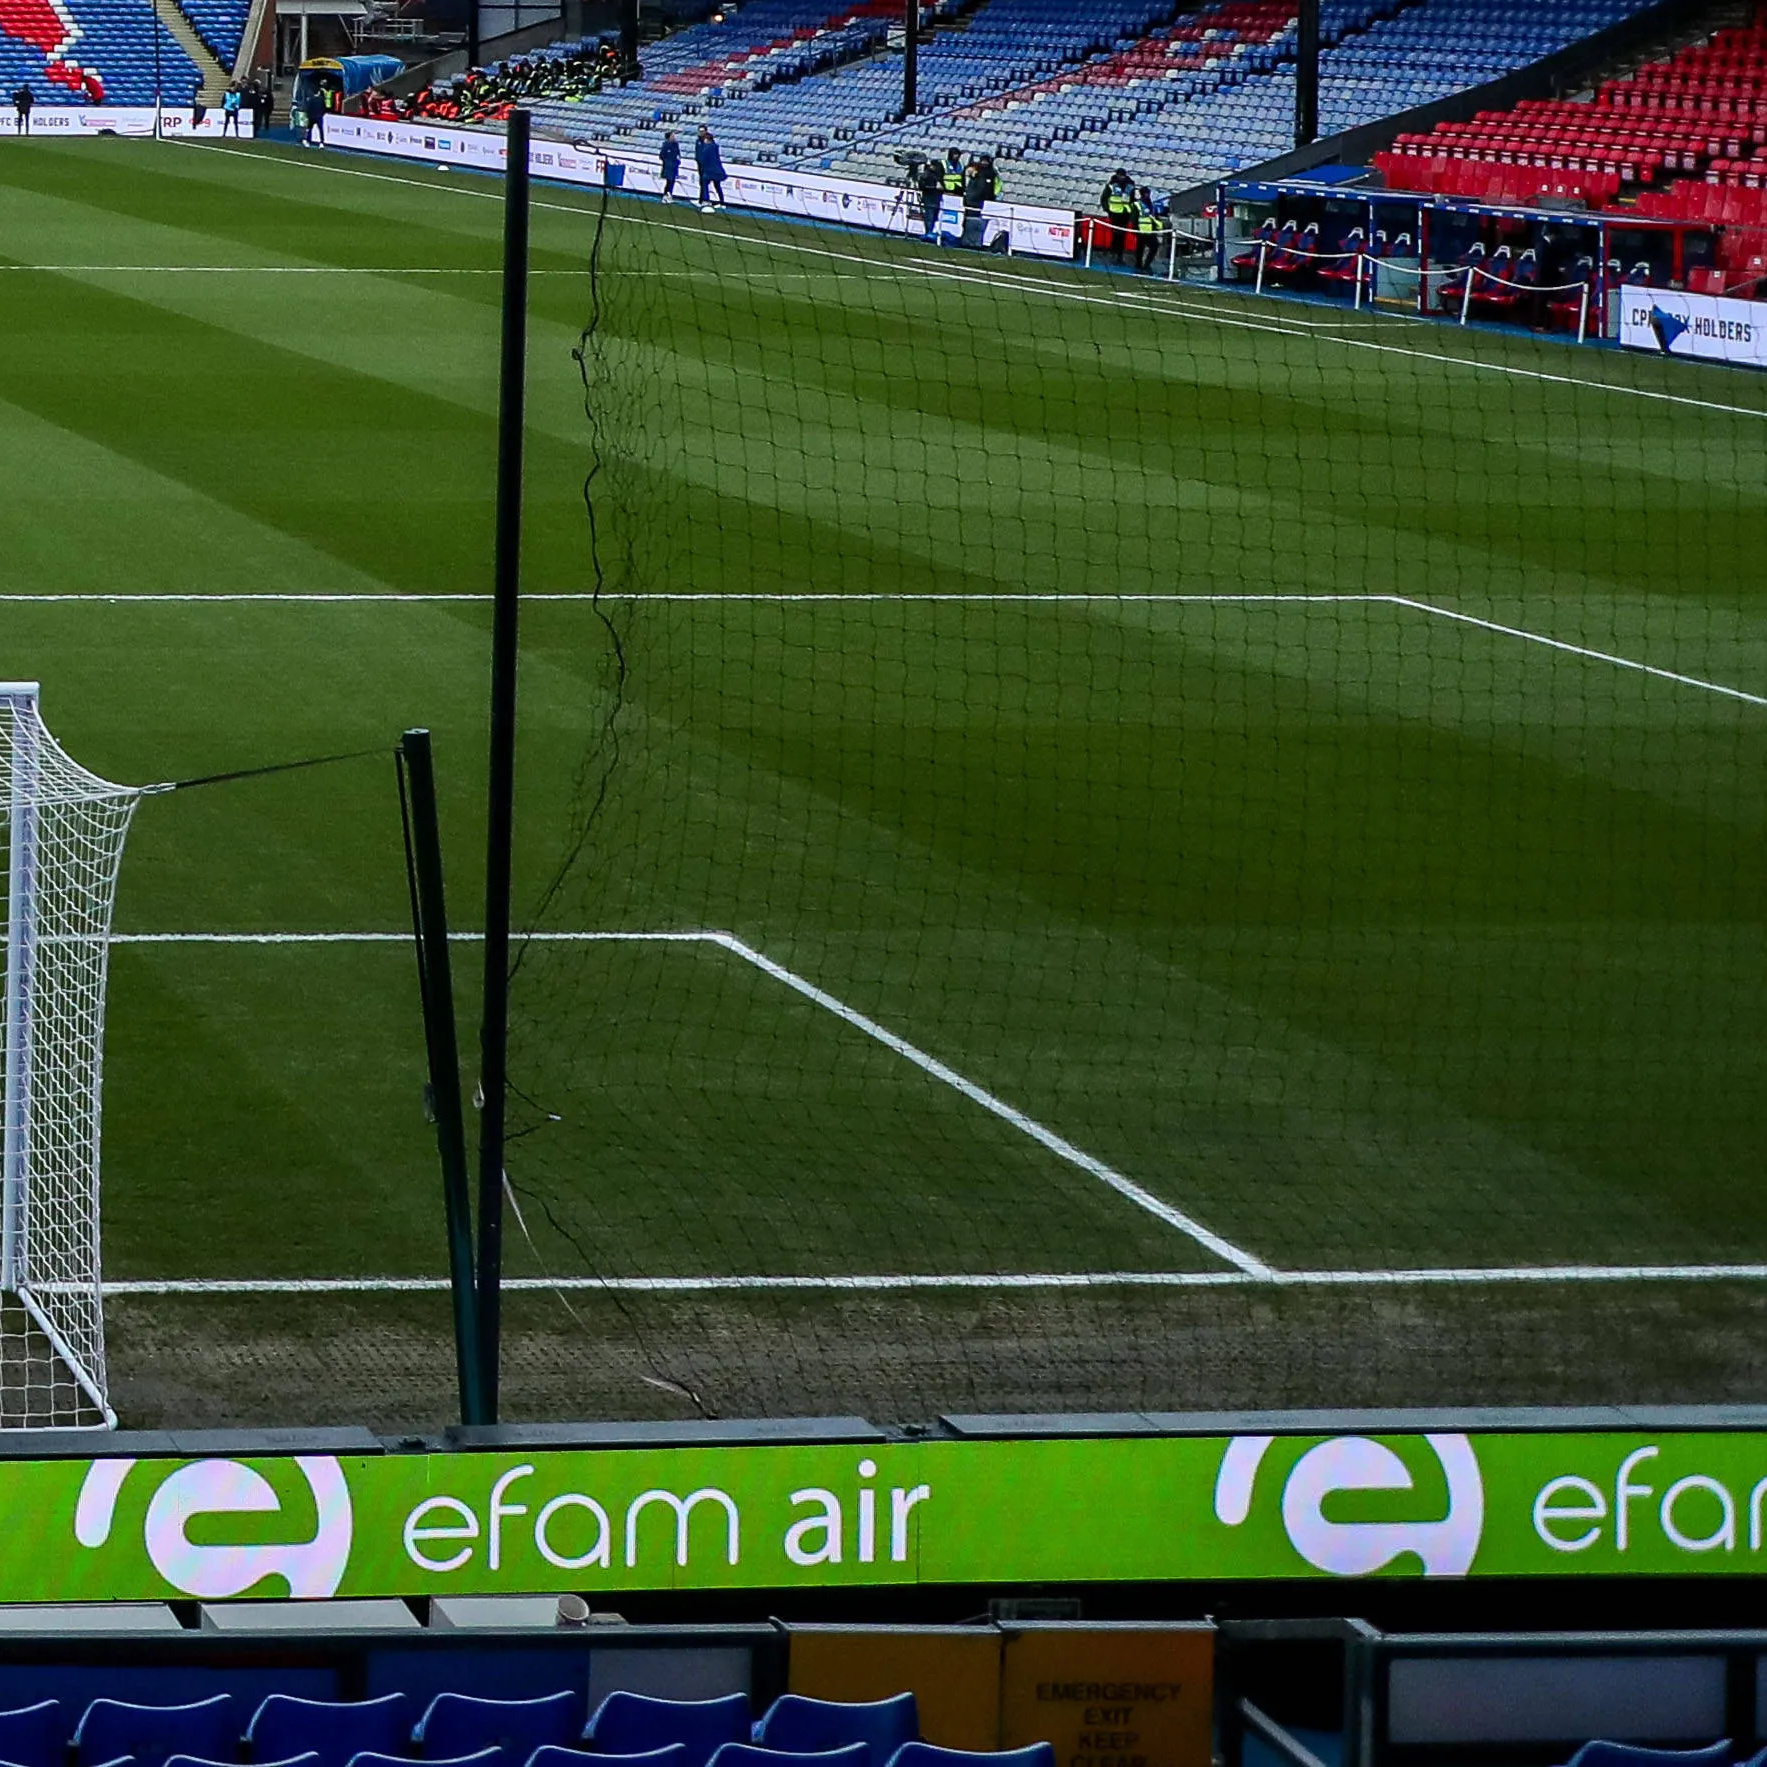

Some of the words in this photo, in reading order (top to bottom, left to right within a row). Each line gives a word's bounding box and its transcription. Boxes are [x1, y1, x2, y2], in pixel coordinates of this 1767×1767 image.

[32, 117, 70, 126] HOLDERS
[1695, 316, 1752, 342] HOLDERS
[403, 1465, 739, 1571] efam
[784, 1460, 930, 1565] air
[1036, 1682, 1182, 1702] EMERGENCY
[1083, 1707, 1135, 1726] EXIT
[1078, 1732, 1139, 1750] KEEP
